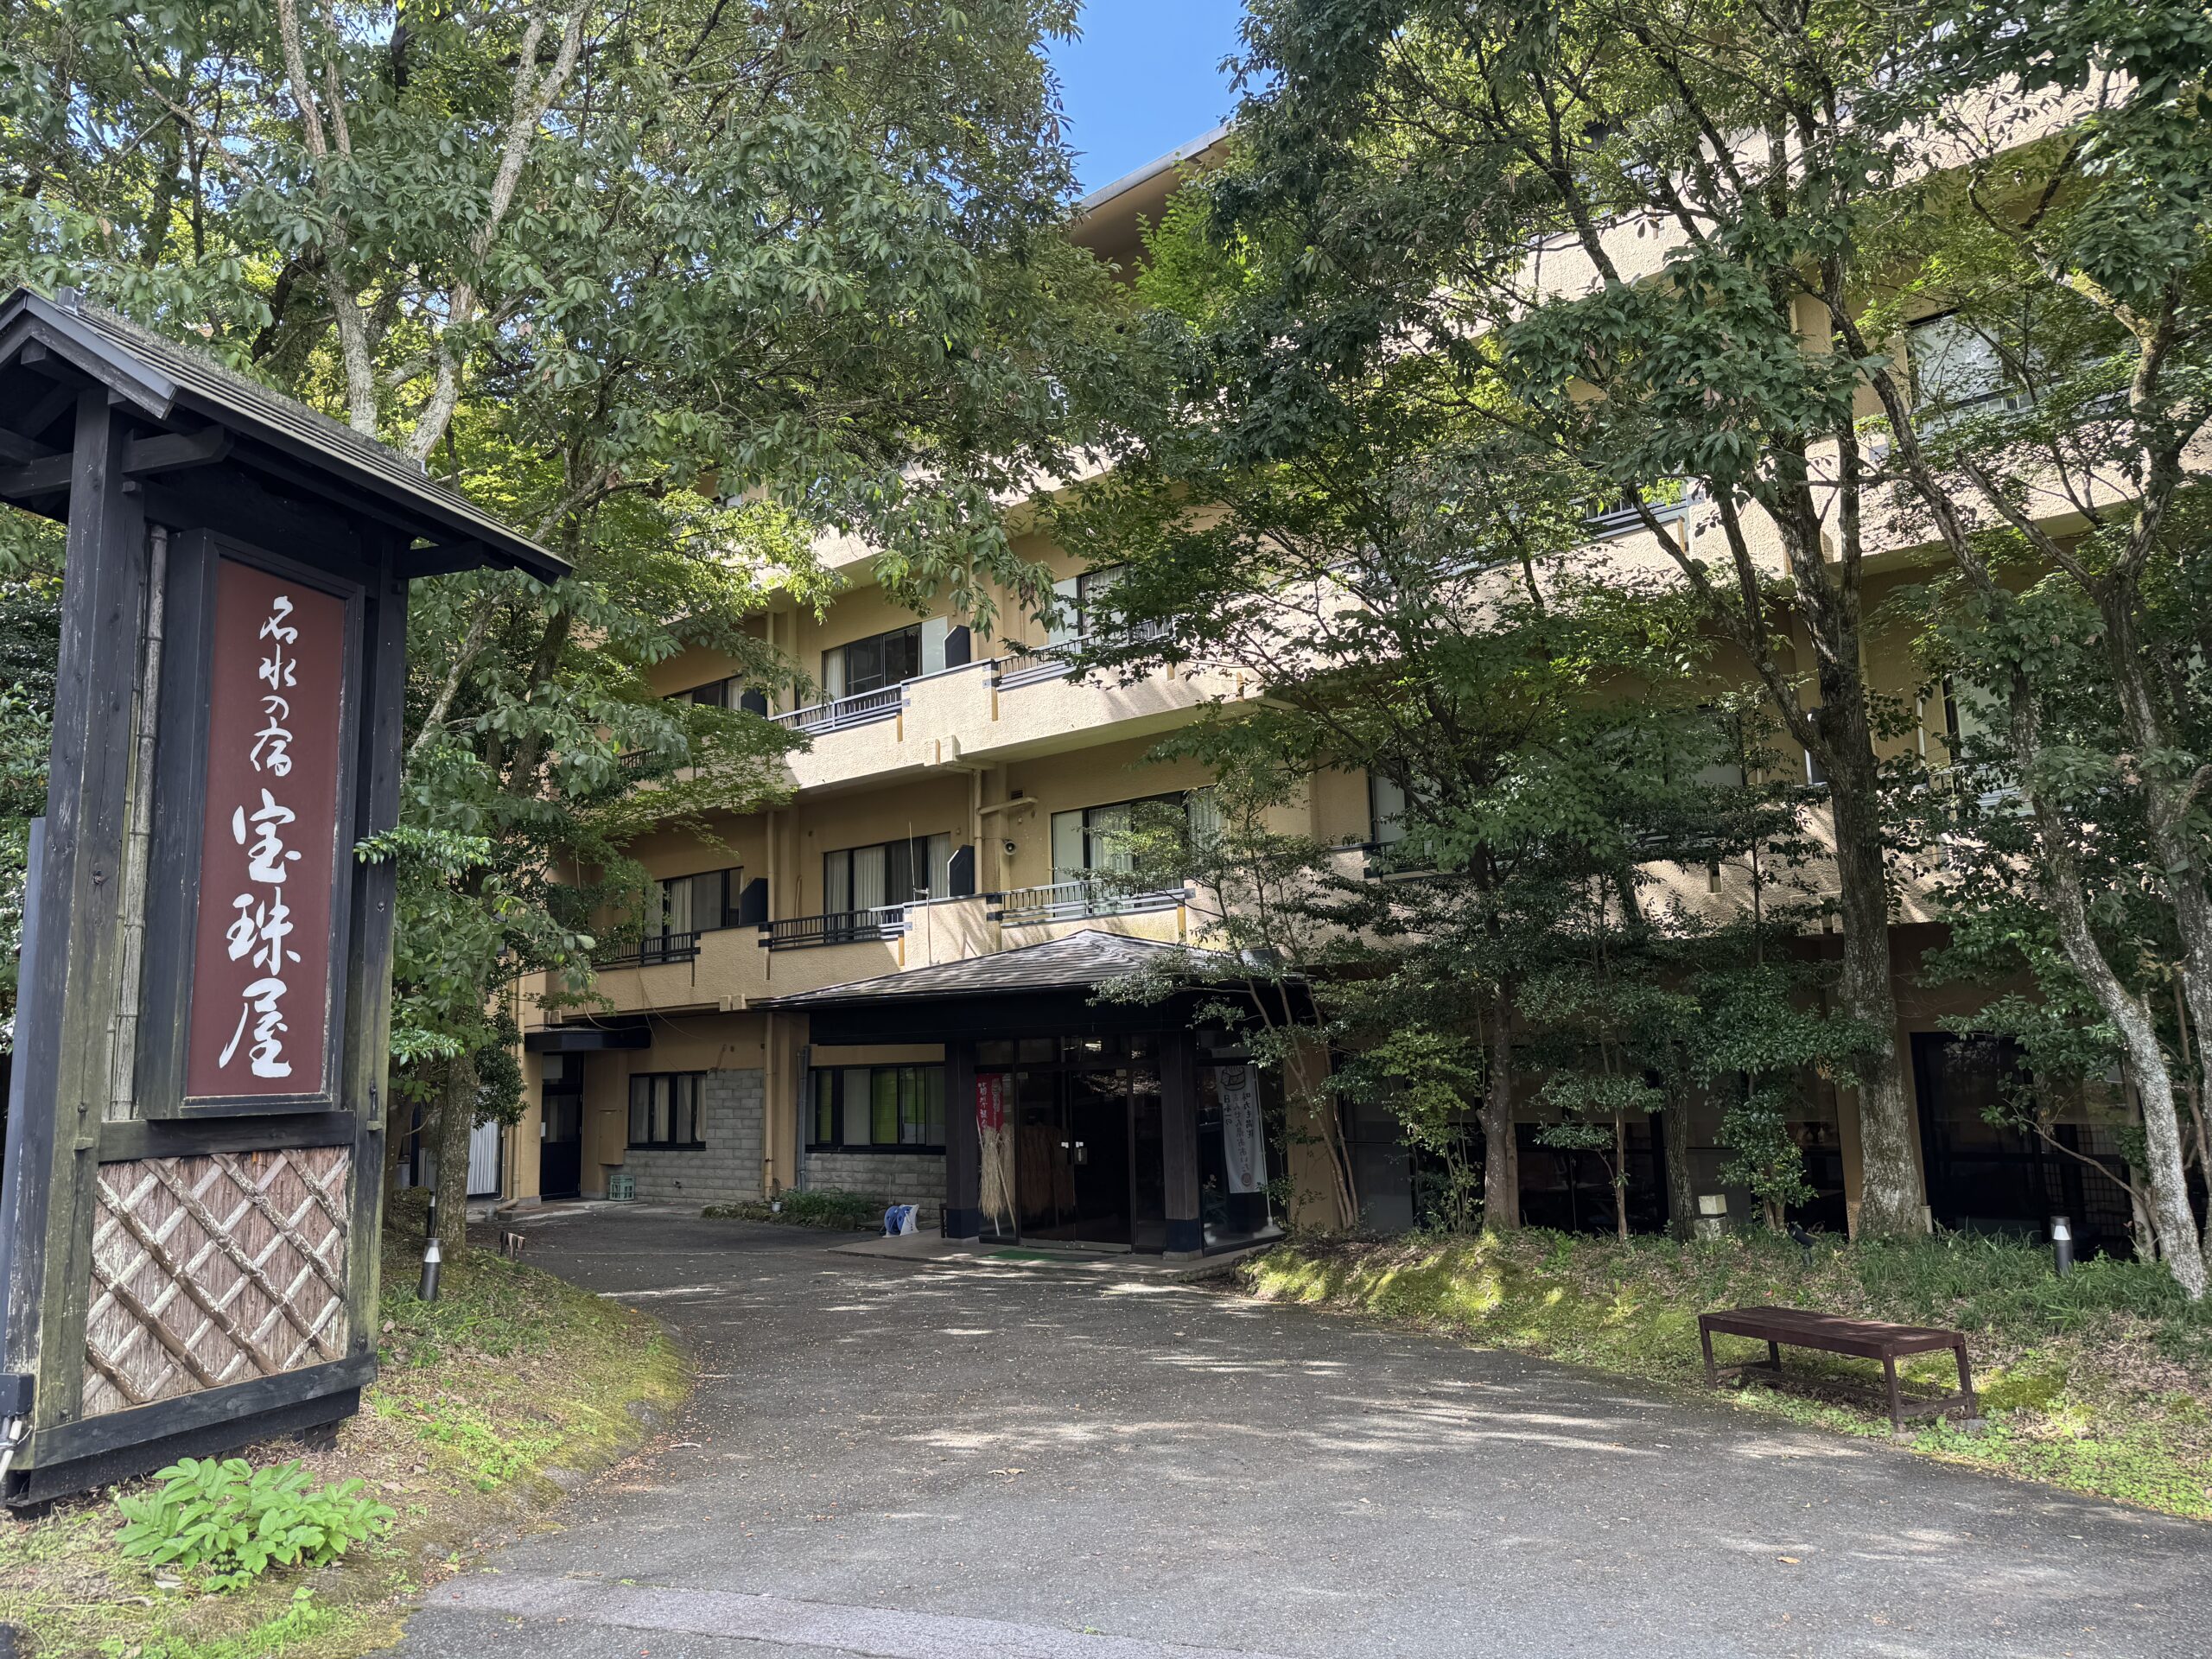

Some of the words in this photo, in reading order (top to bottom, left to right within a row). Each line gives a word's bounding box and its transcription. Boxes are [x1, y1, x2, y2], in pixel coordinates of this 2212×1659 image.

[251, 596, 297, 776] 名水の宿
[219, 788, 302, 1077] 宝珠屋
